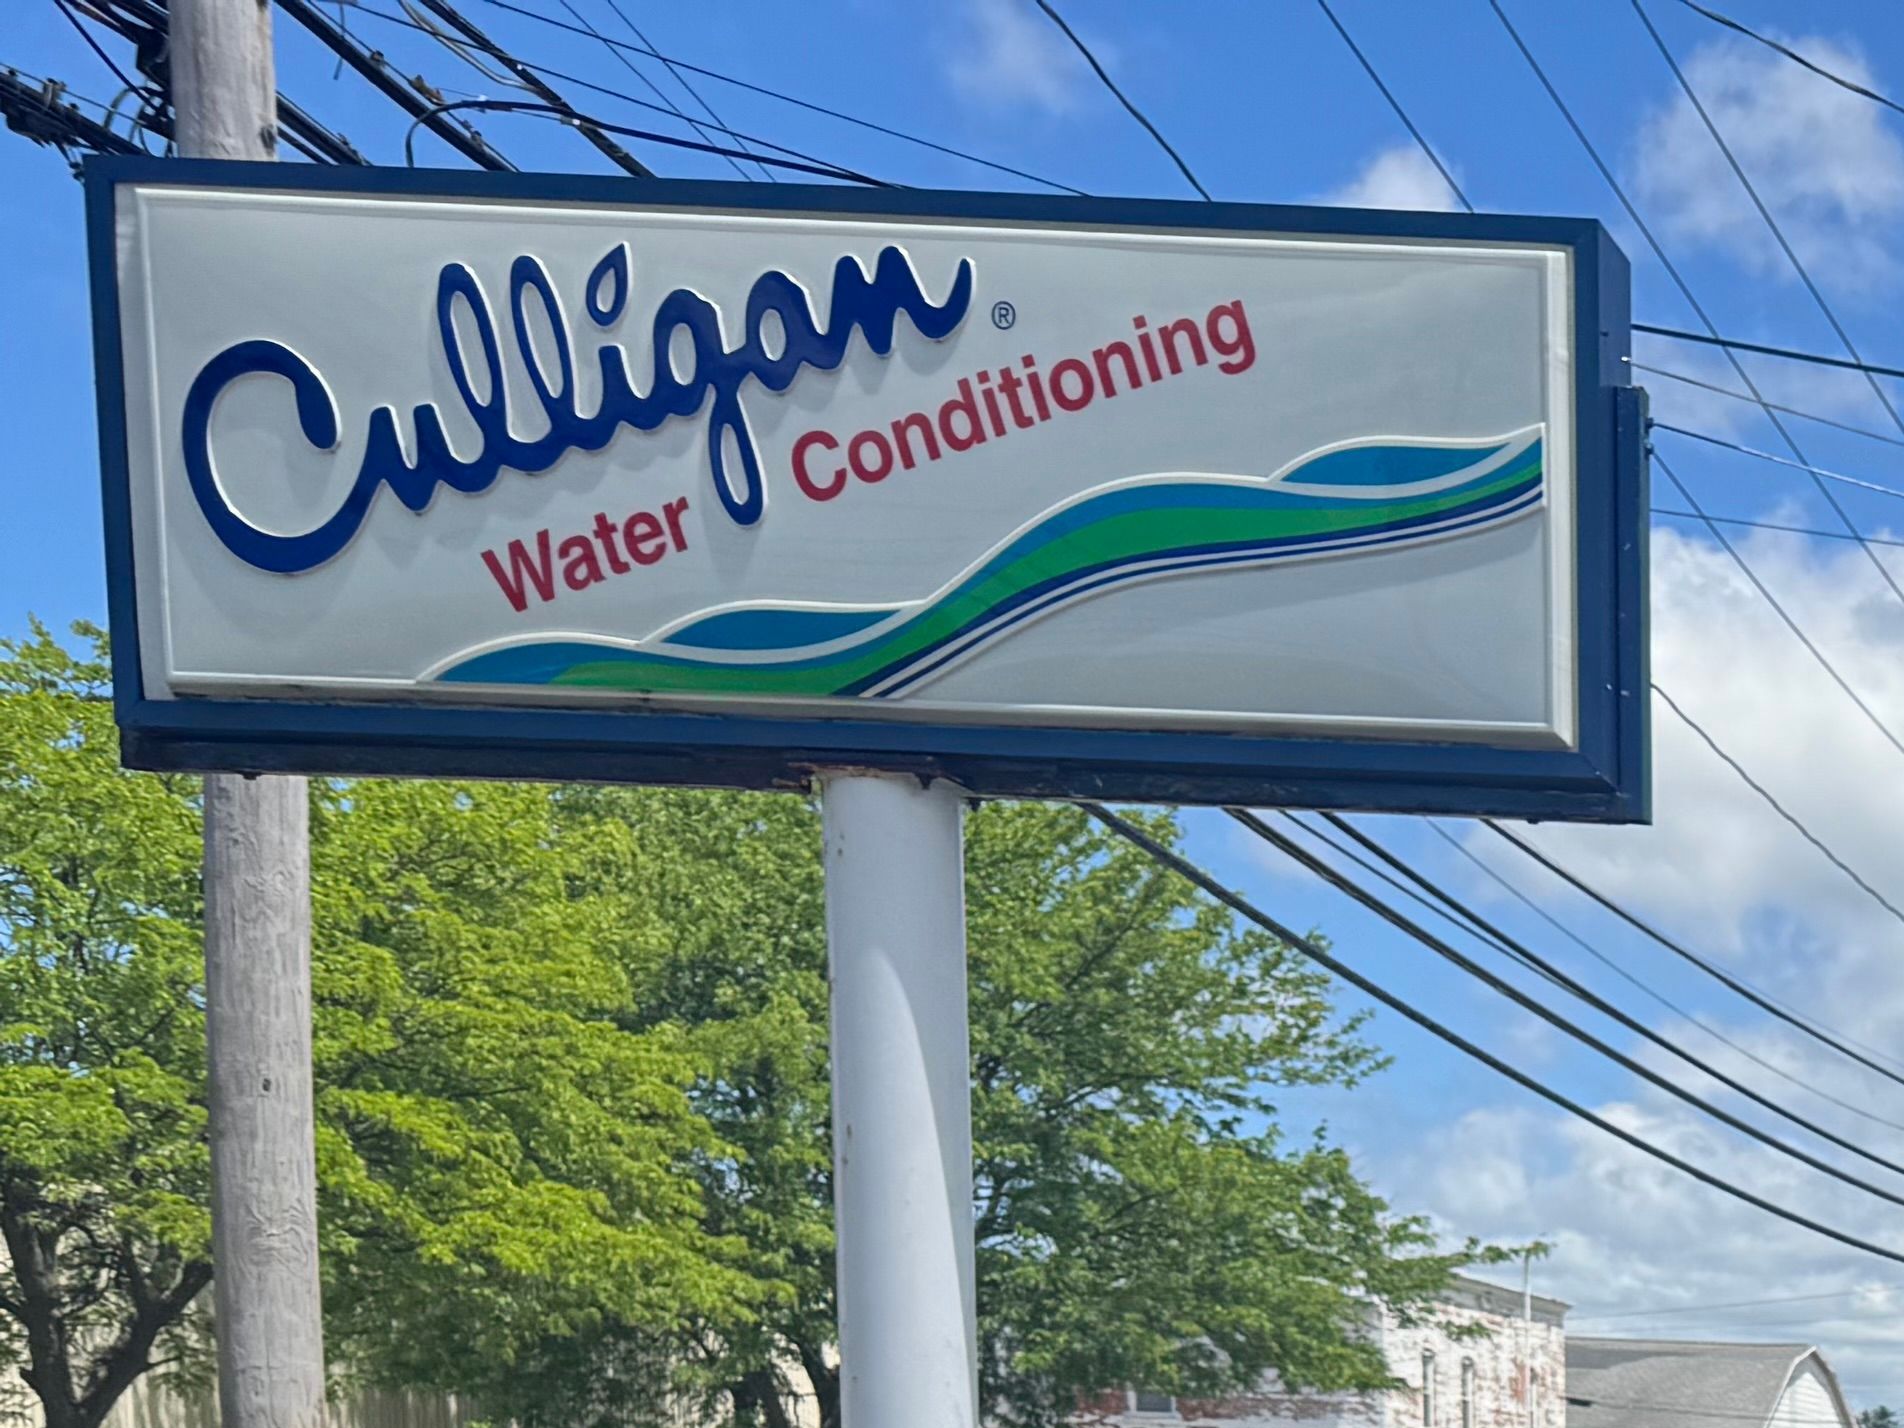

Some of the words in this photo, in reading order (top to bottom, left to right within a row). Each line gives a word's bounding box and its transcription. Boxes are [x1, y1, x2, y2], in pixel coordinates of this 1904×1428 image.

[182, 244, 973, 575] Culligan
[482, 498, 689, 613] Water
[792, 300, 1256, 502] Conditioning
